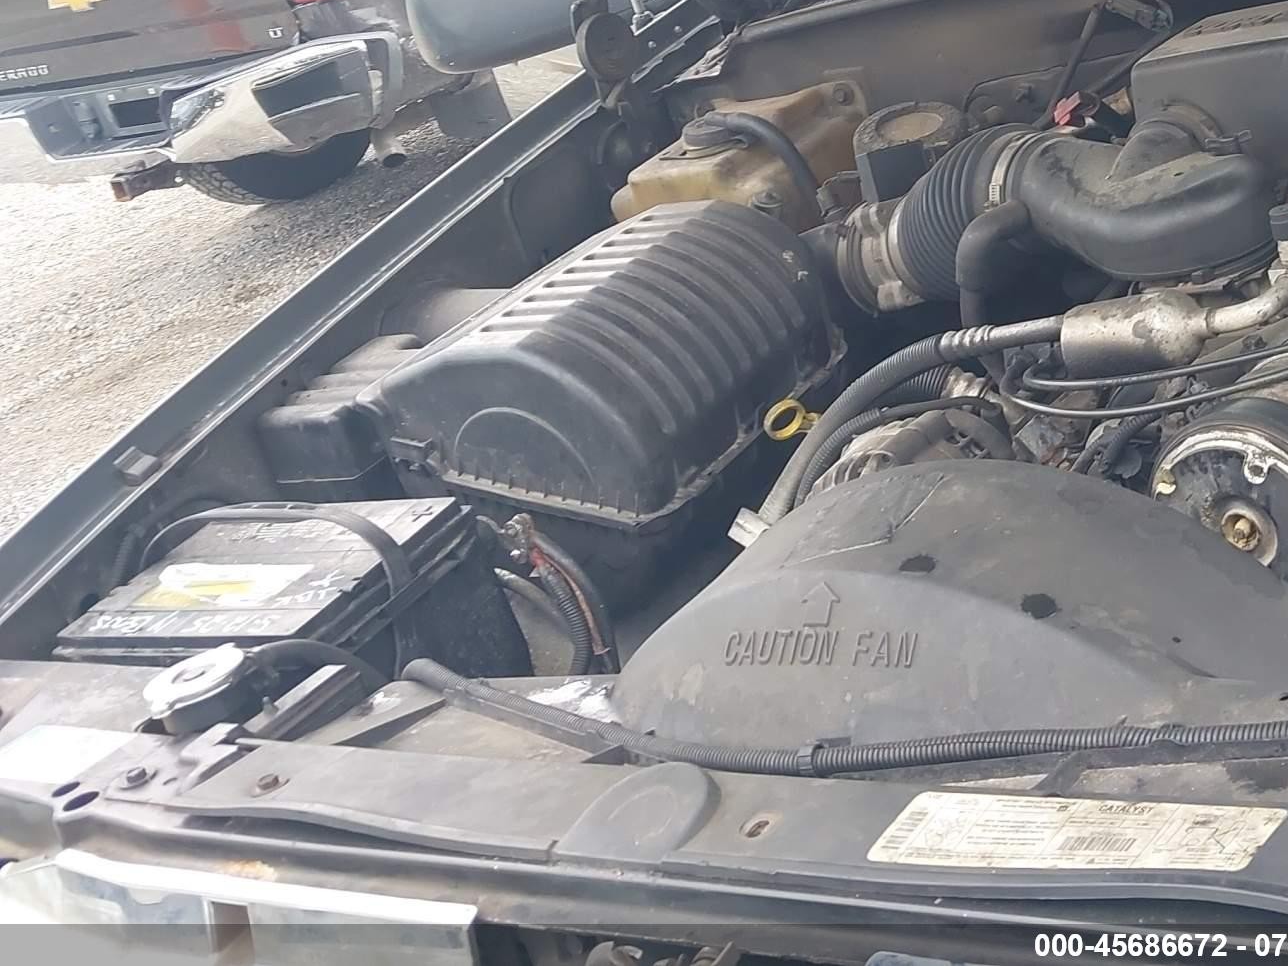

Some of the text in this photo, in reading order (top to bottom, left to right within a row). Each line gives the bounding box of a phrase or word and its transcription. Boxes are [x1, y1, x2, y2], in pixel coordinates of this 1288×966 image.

[723, 630, 919, 668] CAUTION FAN
[1097, 804, 1154, 815] CATALYST
